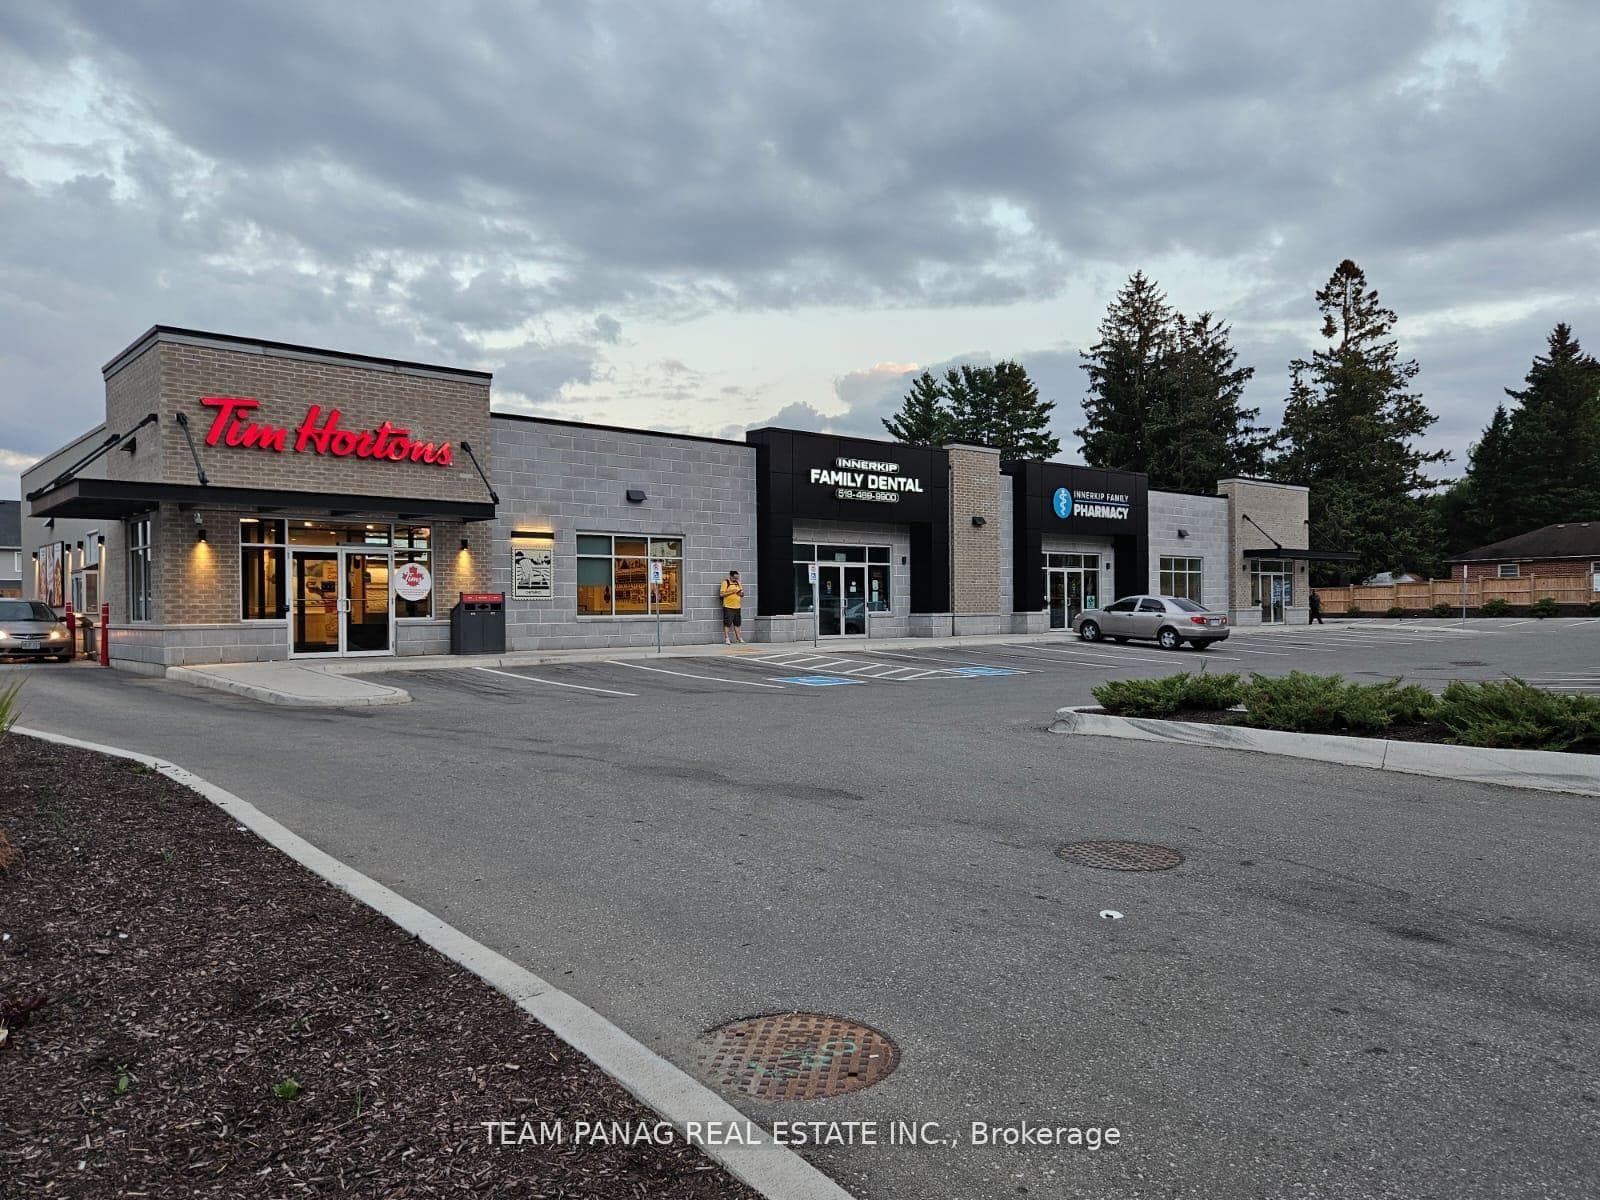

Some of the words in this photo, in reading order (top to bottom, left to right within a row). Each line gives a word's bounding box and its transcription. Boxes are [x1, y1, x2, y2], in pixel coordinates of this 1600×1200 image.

[200, 397, 288, 452] Tim
[294, 404, 453, 466] Hortons
[837, 458, 899, 473] INNERKIP
[810, 468, 864, 487] FAMILY
[867, 474, 924, 493] DENTAL
[1073, 490, 1105, 500] INNERKIP
[1106, 493, 1129, 503] FAMILY
[1073, 503, 1129, 519] PHARMACY
